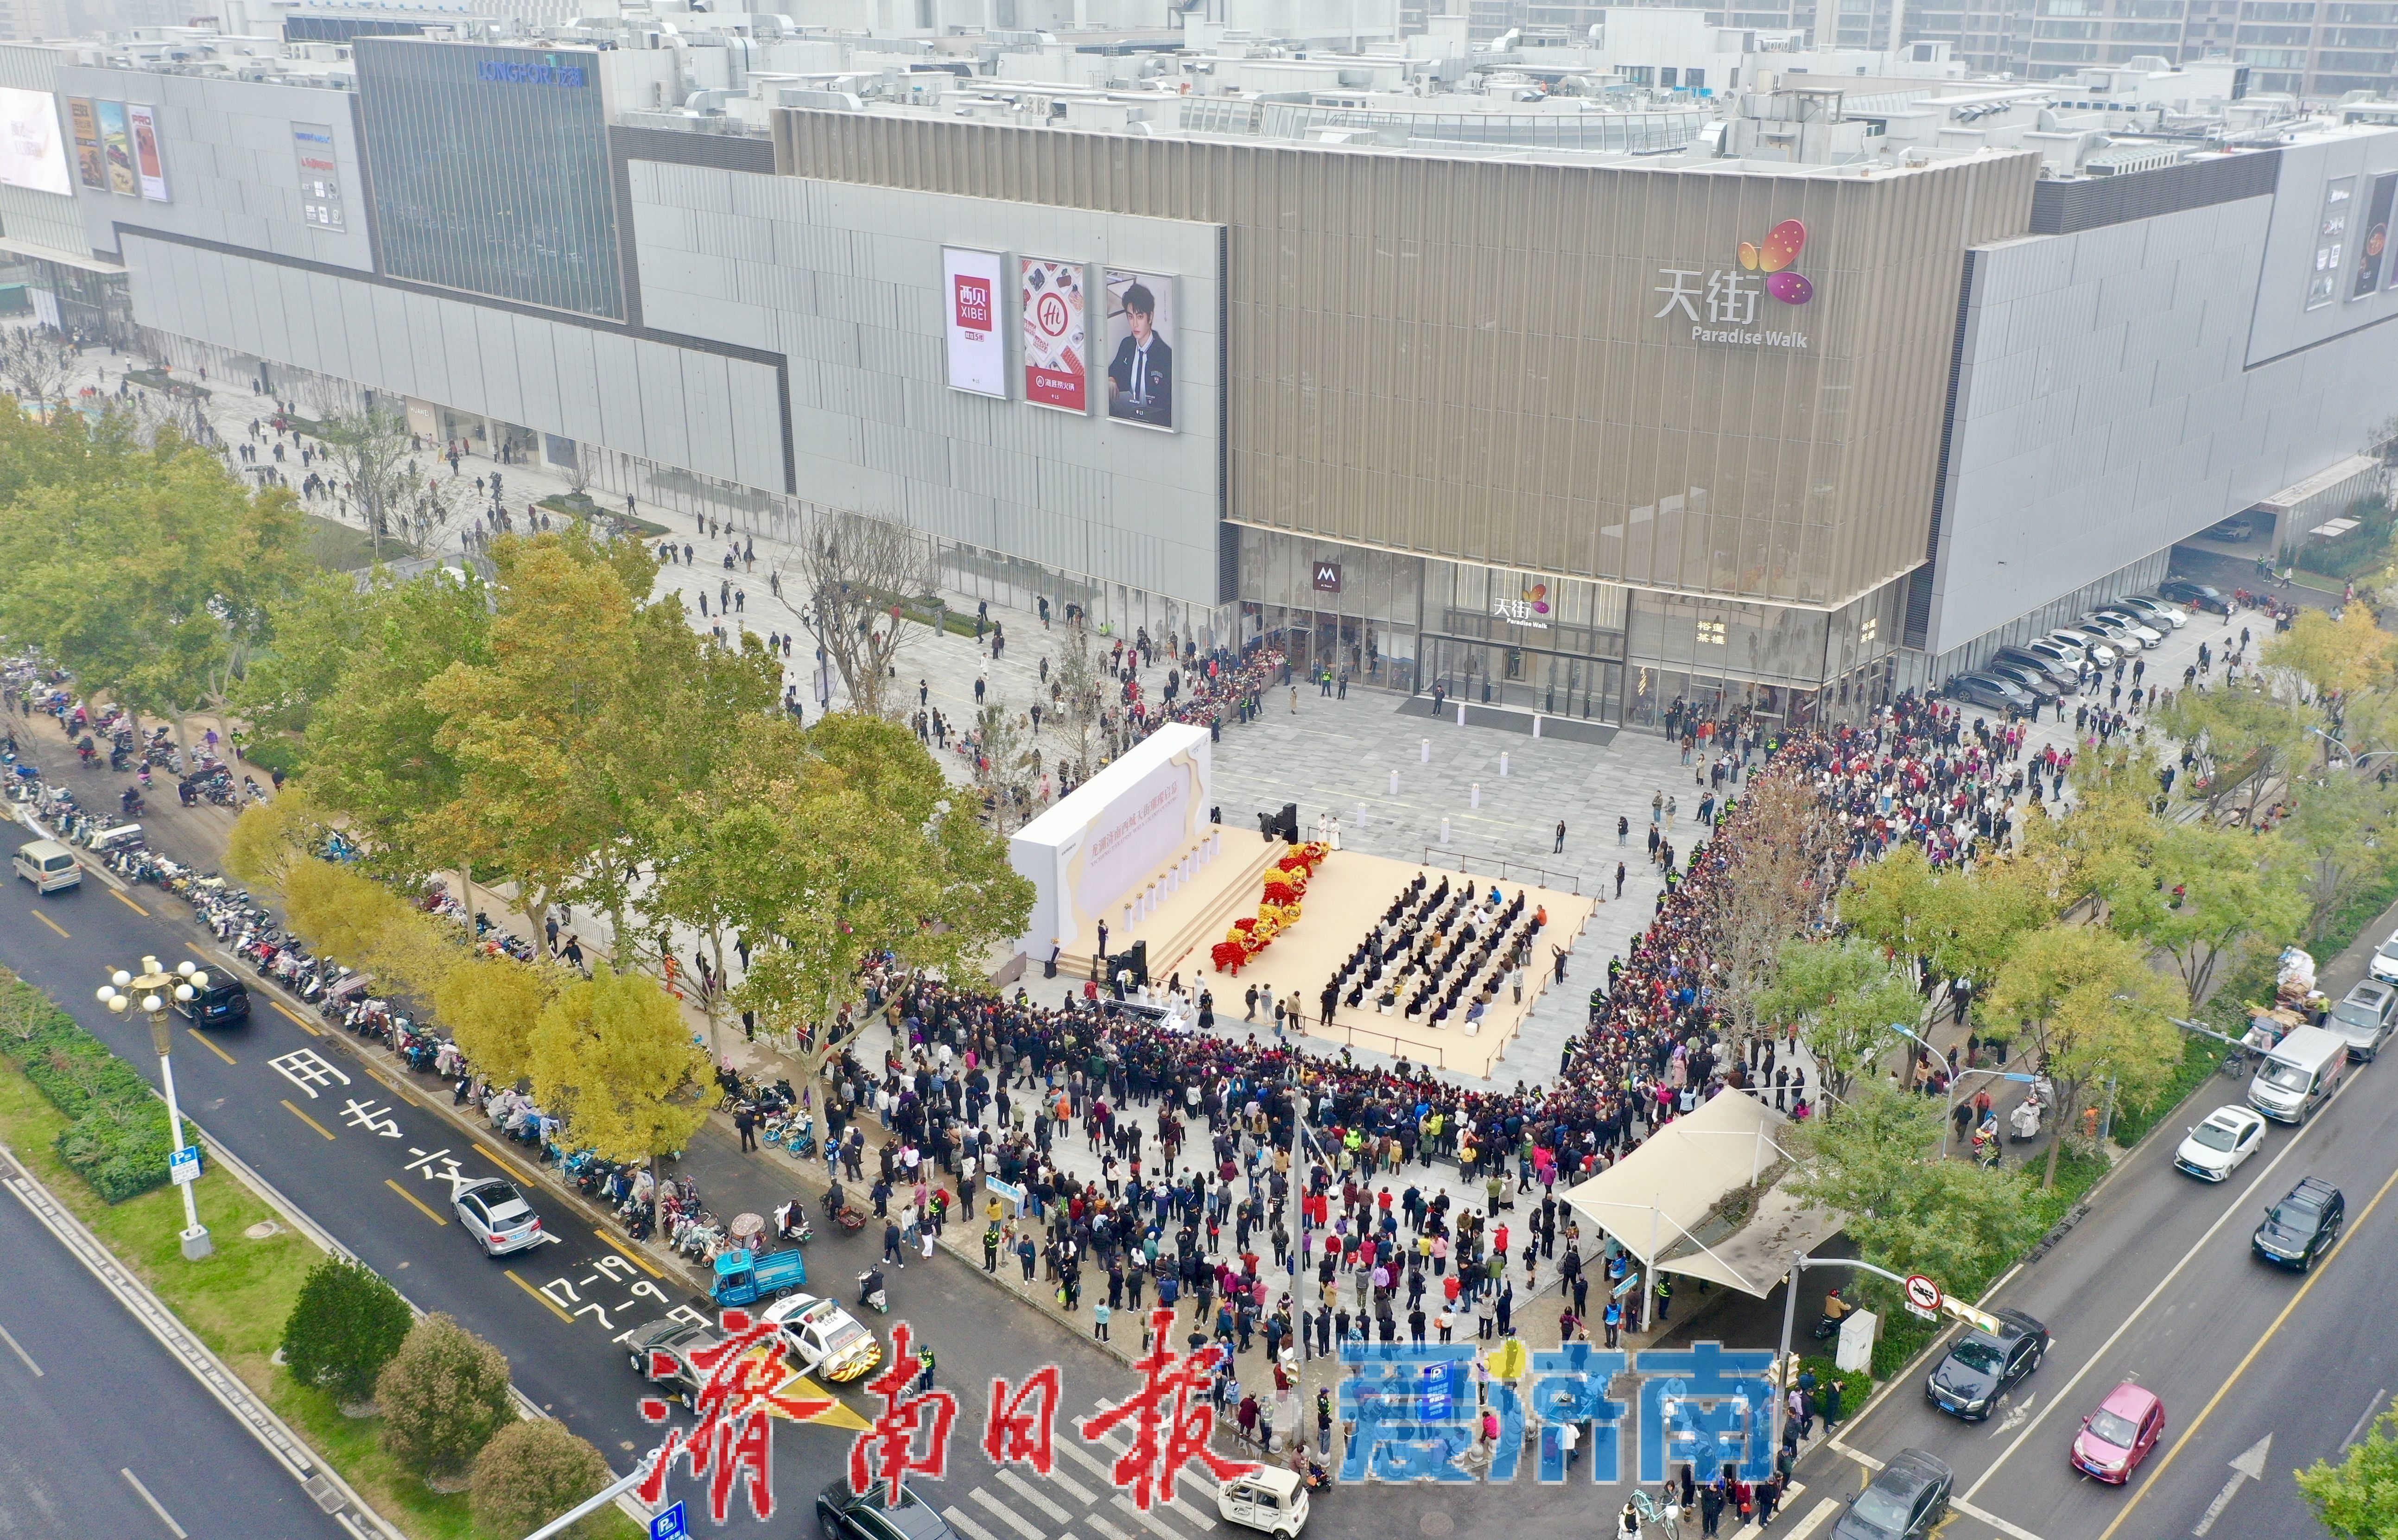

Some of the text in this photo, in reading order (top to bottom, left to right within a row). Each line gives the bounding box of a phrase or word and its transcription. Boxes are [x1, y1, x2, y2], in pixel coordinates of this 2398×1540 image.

[478, 60, 583, 88] LONGFOR 龙湖
[132, 114, 152, 125] PRO
[959, 285, 985, 307] 西贝
[1653, 269, 1760, 324] 天街
[961, 305, 987, 321] XIBEI
[1044, 301, 1061, 326] Hi
[1692, 326, 1808, 348] Paradise Walk
[1045, 379, 1075, 392] 海底捞火锅
[410, 406, 429, 417] HUAWEI
[1493, 598, 1531, 620] 天街
[1506, 618, 1532, 627] Paradise
[539, 1255, 638, 1308] 17-19
[574, 1281, 669, 1329] 7-9
[824, 1316, 838, 1326] 9237
[1922, 1311, 1934, 1320] 中型
[802, 1344, 811, 1355] 公安
